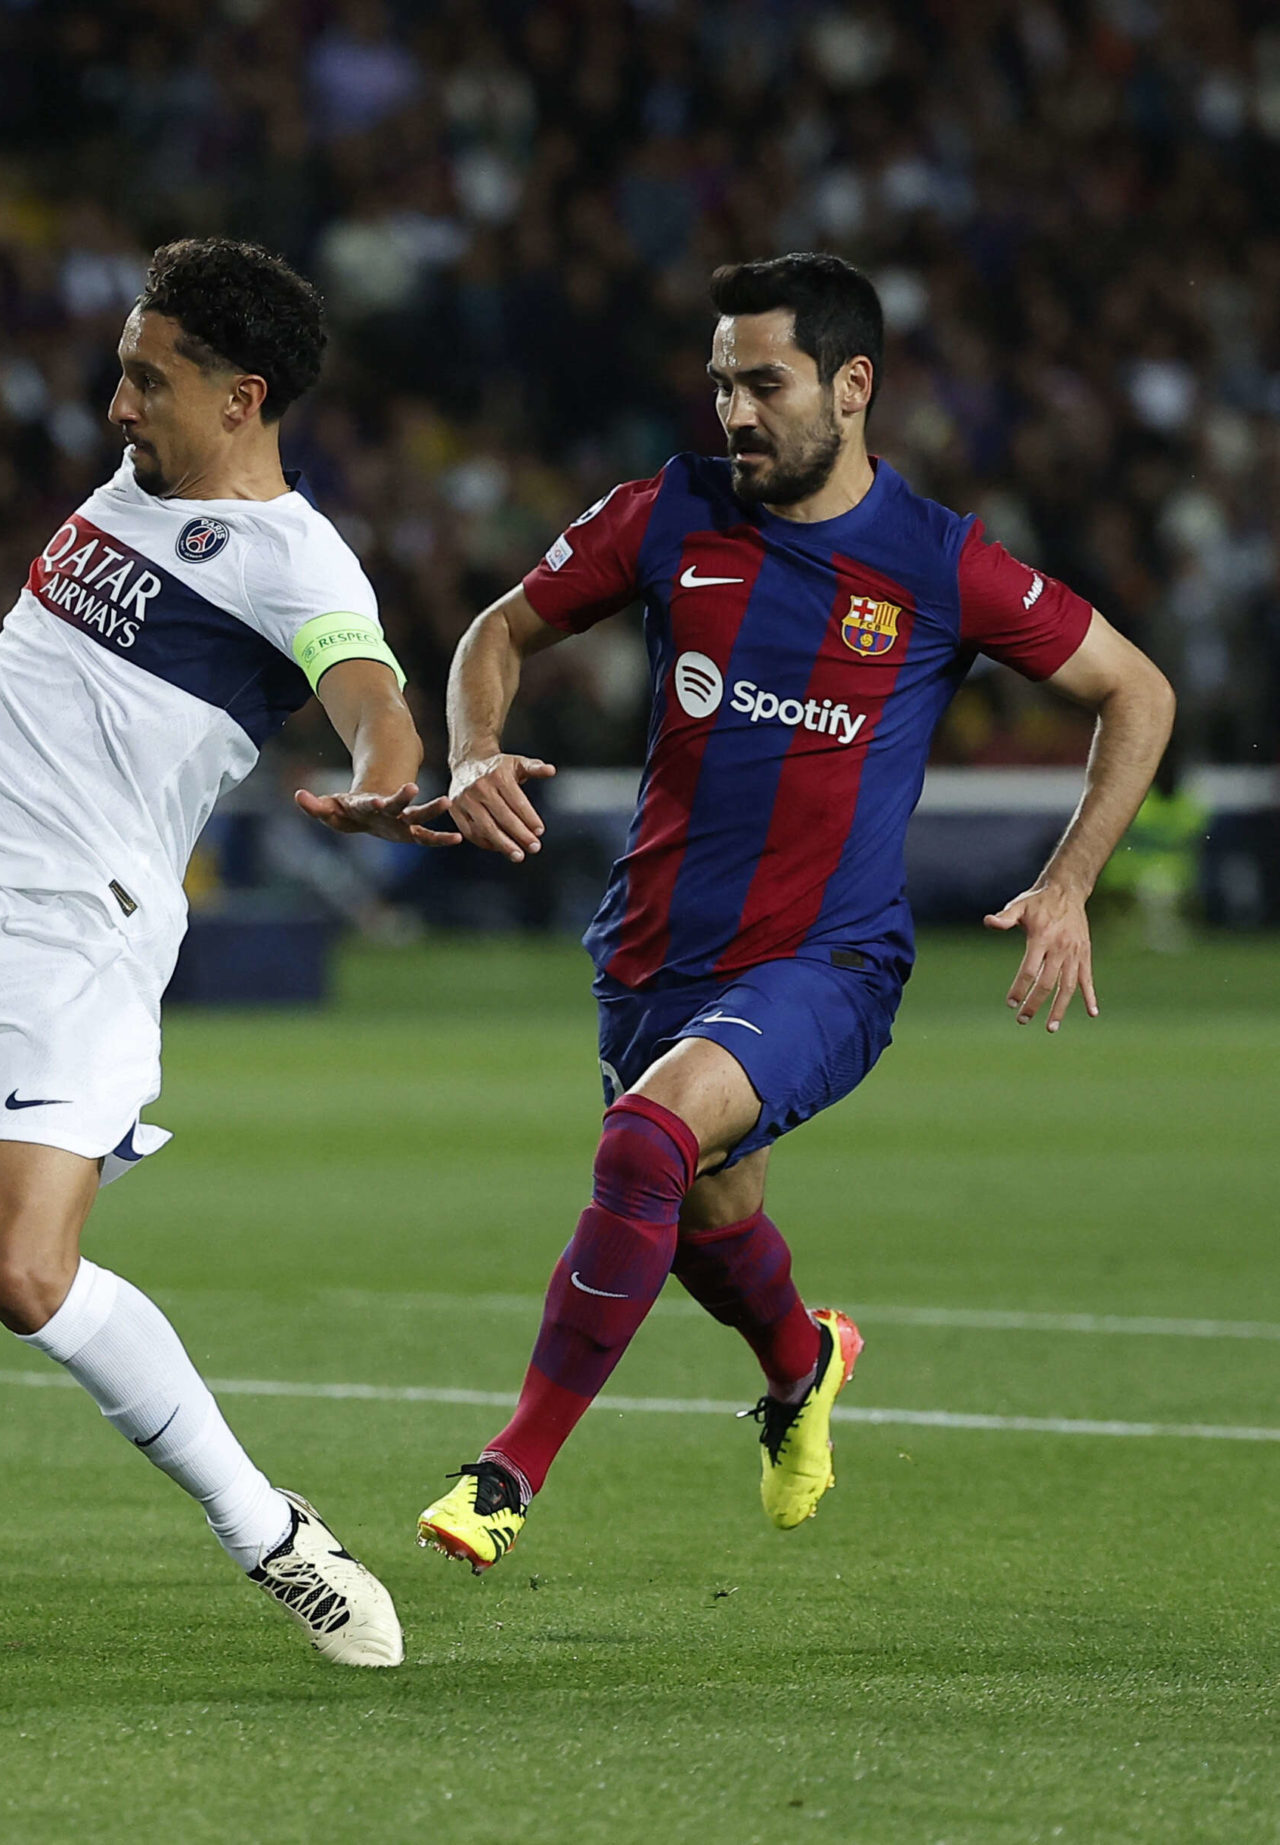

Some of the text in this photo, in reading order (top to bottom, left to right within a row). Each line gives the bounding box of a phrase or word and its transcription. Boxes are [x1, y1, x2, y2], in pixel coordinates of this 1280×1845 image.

[201, 520, 226, 540] PARIS
[42, 523, 162, 622] QATAR
[39, 572, 141, 648] AIRWAYS
[729, 680, 867, 744] Spotify
